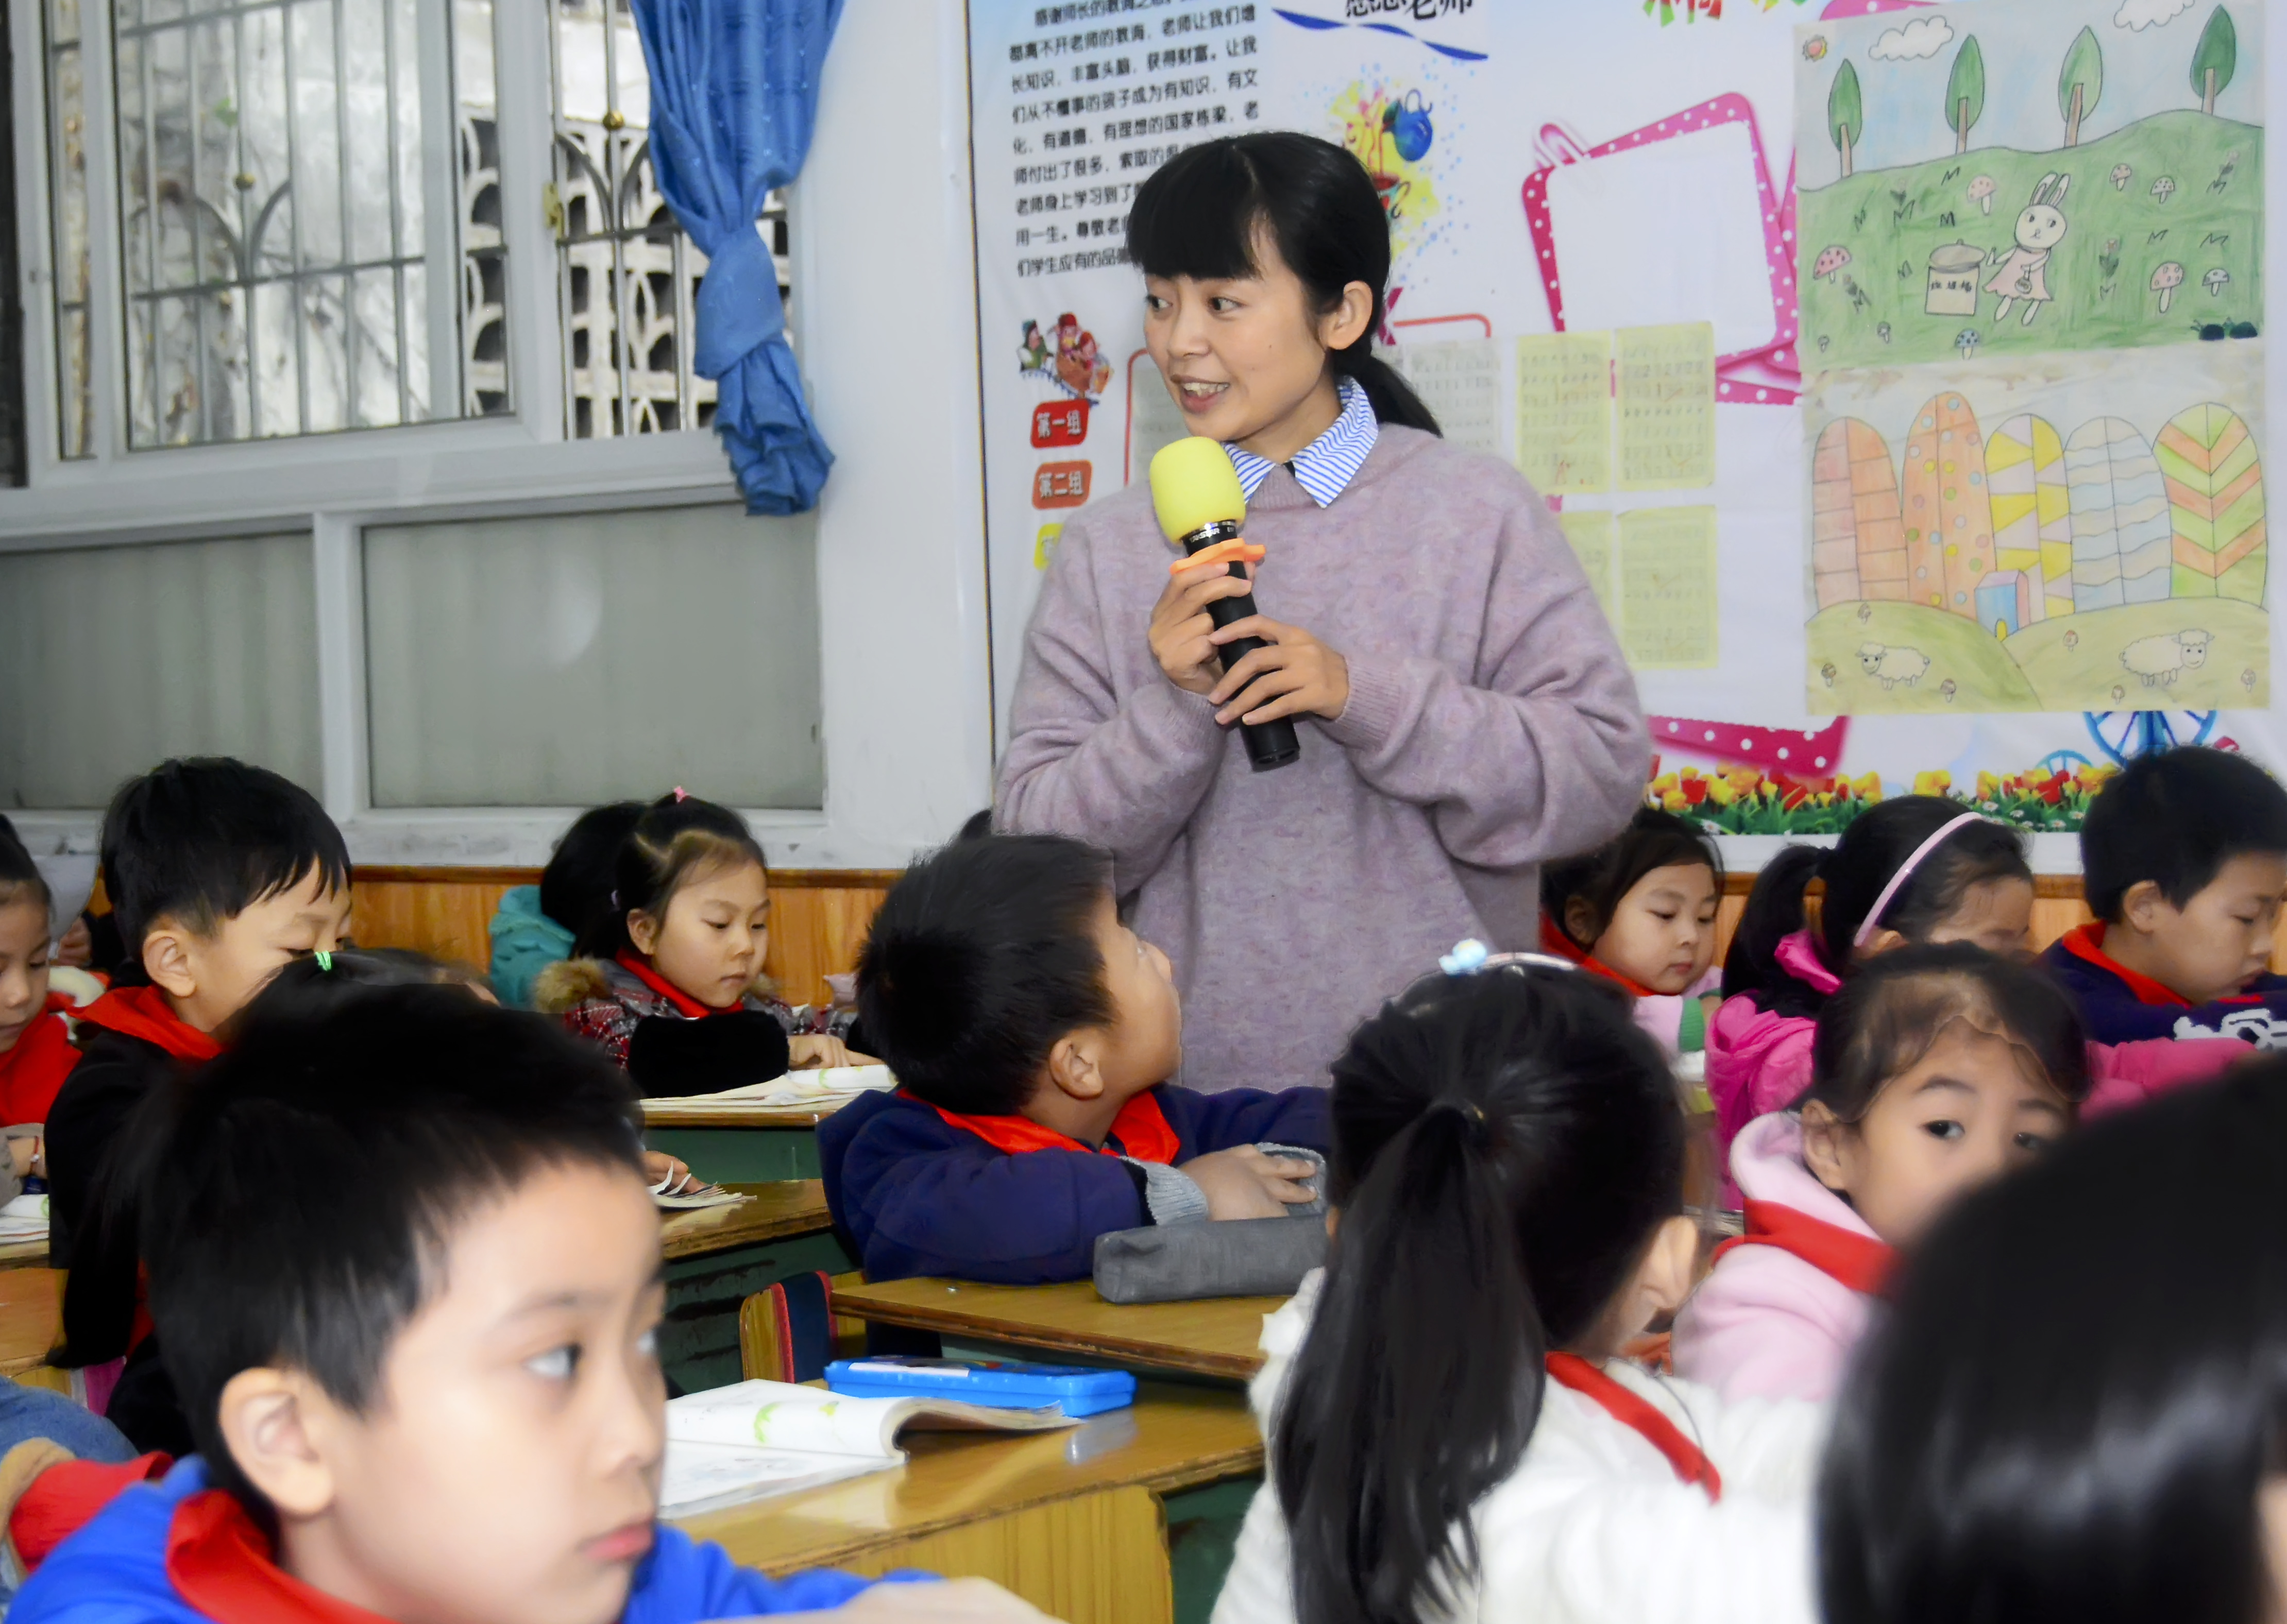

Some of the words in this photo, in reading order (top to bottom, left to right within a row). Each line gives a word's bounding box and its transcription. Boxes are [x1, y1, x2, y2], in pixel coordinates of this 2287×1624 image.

[1037, 410, 1082, 439] 第一组
[1039, 471, 1084, 498] 第二组
[1189, 527, 1220, 543] TAKSAR
